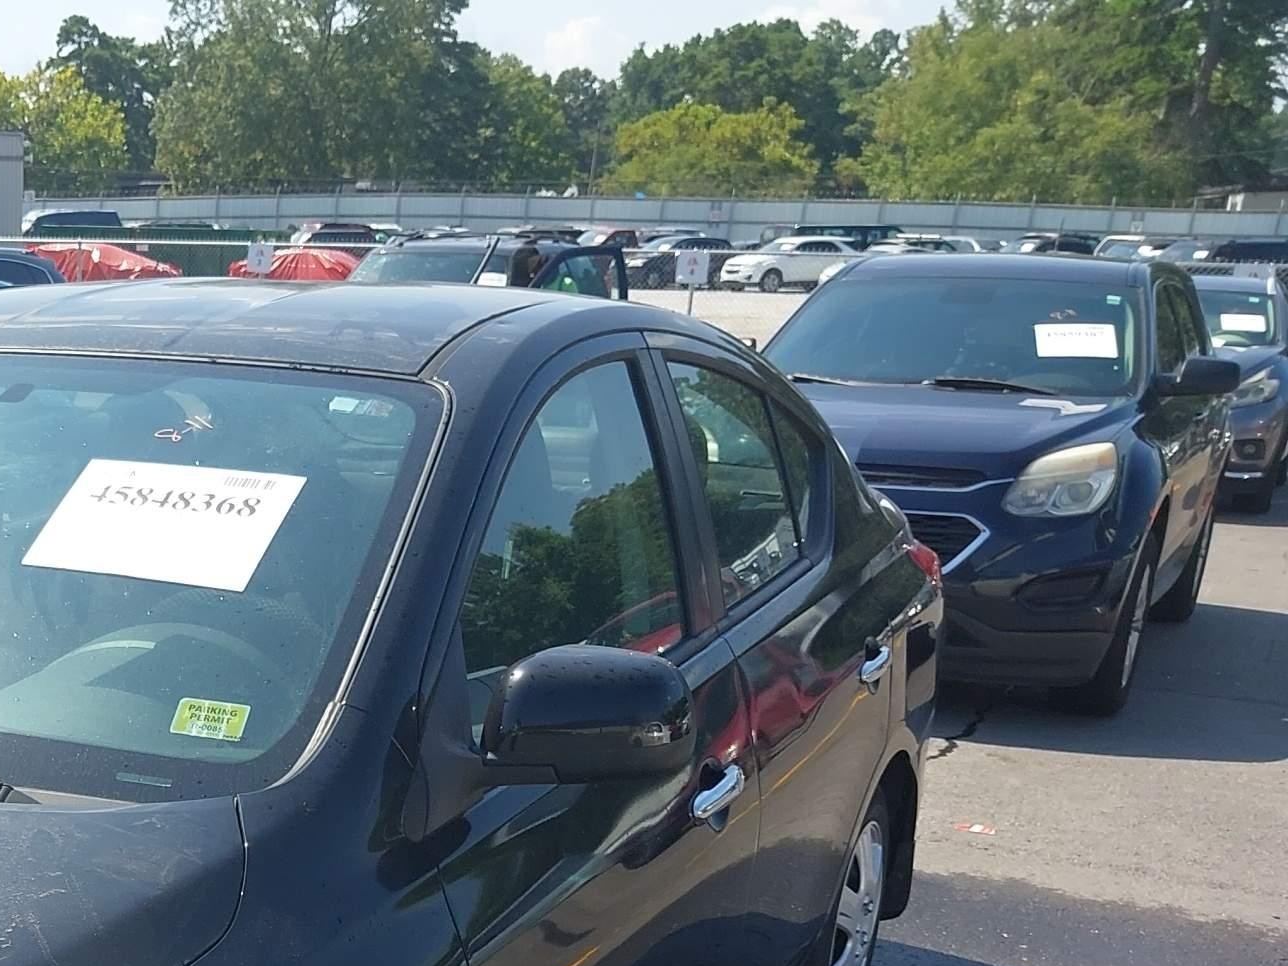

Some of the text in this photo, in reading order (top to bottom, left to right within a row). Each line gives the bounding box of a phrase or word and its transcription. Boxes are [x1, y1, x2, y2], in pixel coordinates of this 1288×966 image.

[90, 485, 261, 517] 45848368
[188, 704, 238, 717] PARKING
[189, 713, 233, 725] PERMIT
